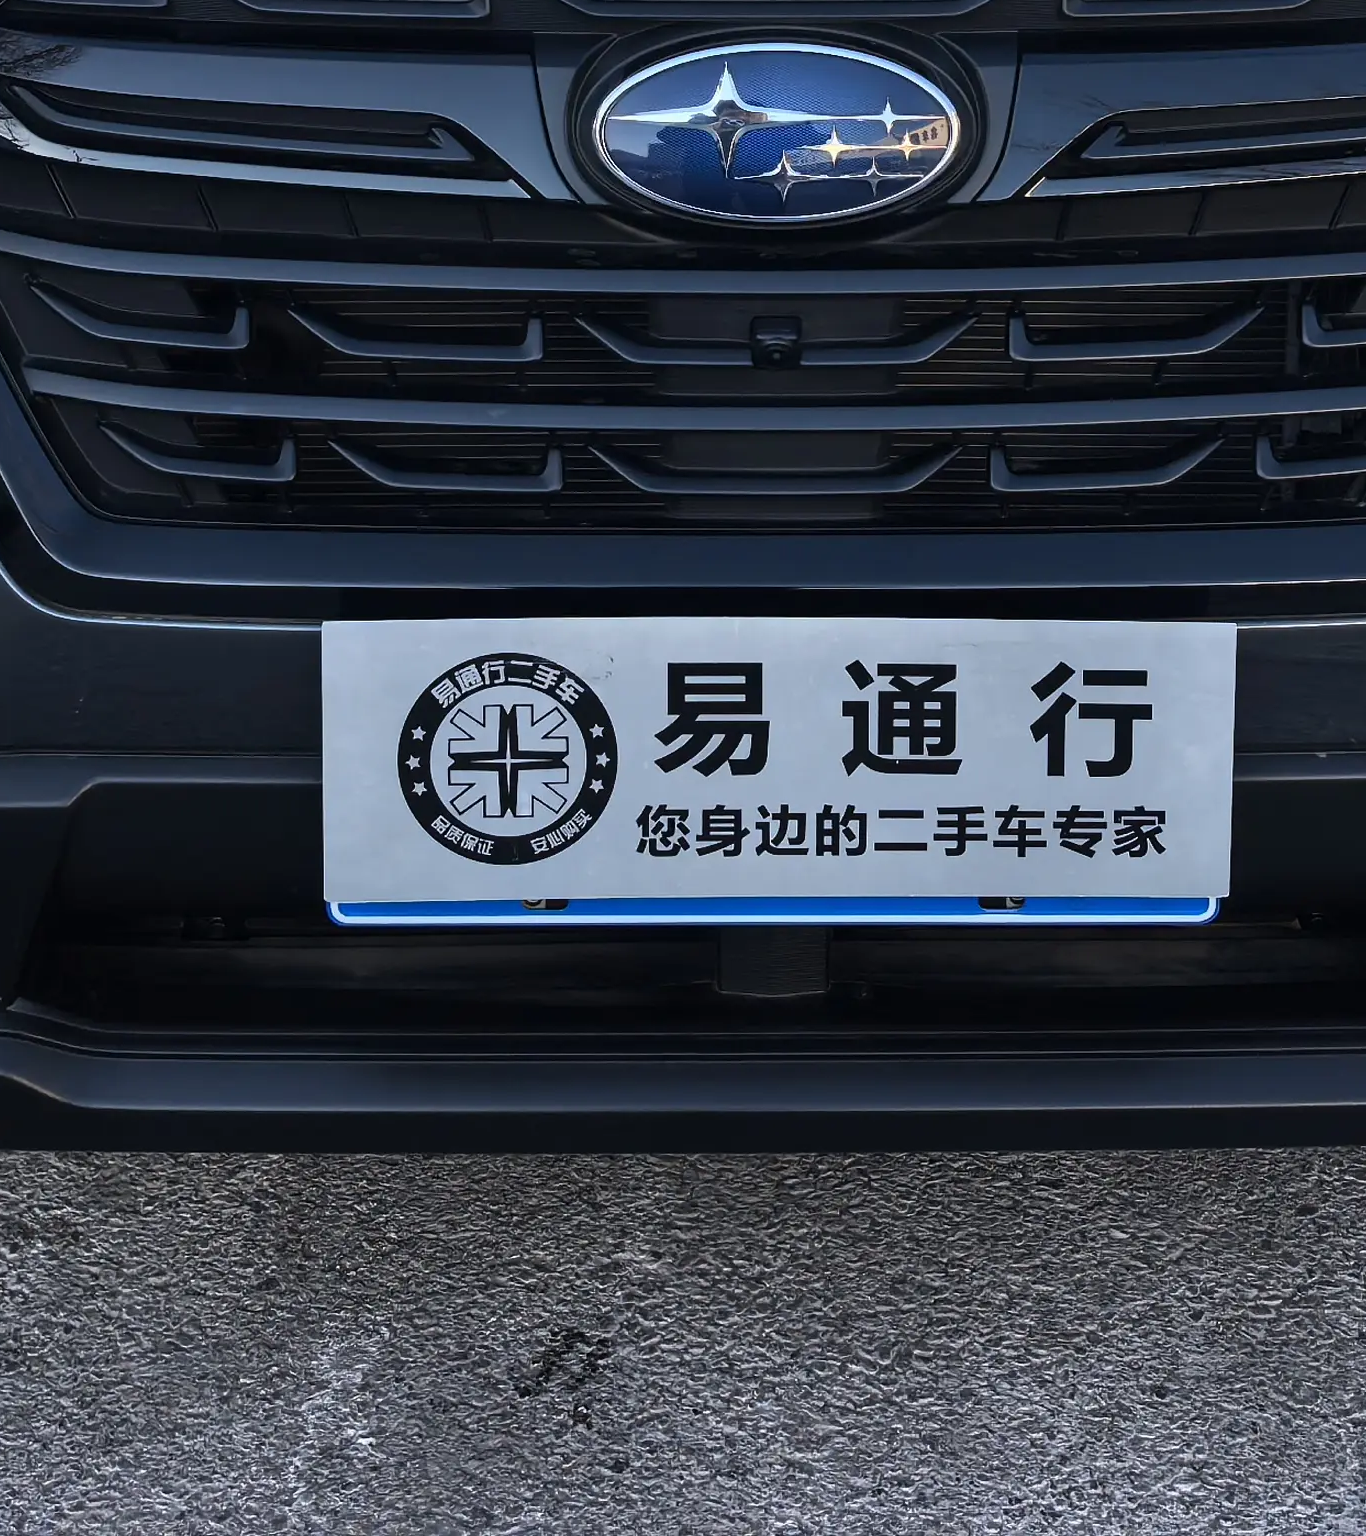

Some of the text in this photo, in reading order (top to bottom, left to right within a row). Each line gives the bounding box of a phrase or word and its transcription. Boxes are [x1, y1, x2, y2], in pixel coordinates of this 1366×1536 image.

[431, 659, 585, 709] 易通行二手车
[653, 659, 1153, 777] 易通行
[430, 814, 495, 856] 品质保证
[529, 808, 593, 855] 安心购买
[635, 804, 1167, 859] 您身边的二手车专家
